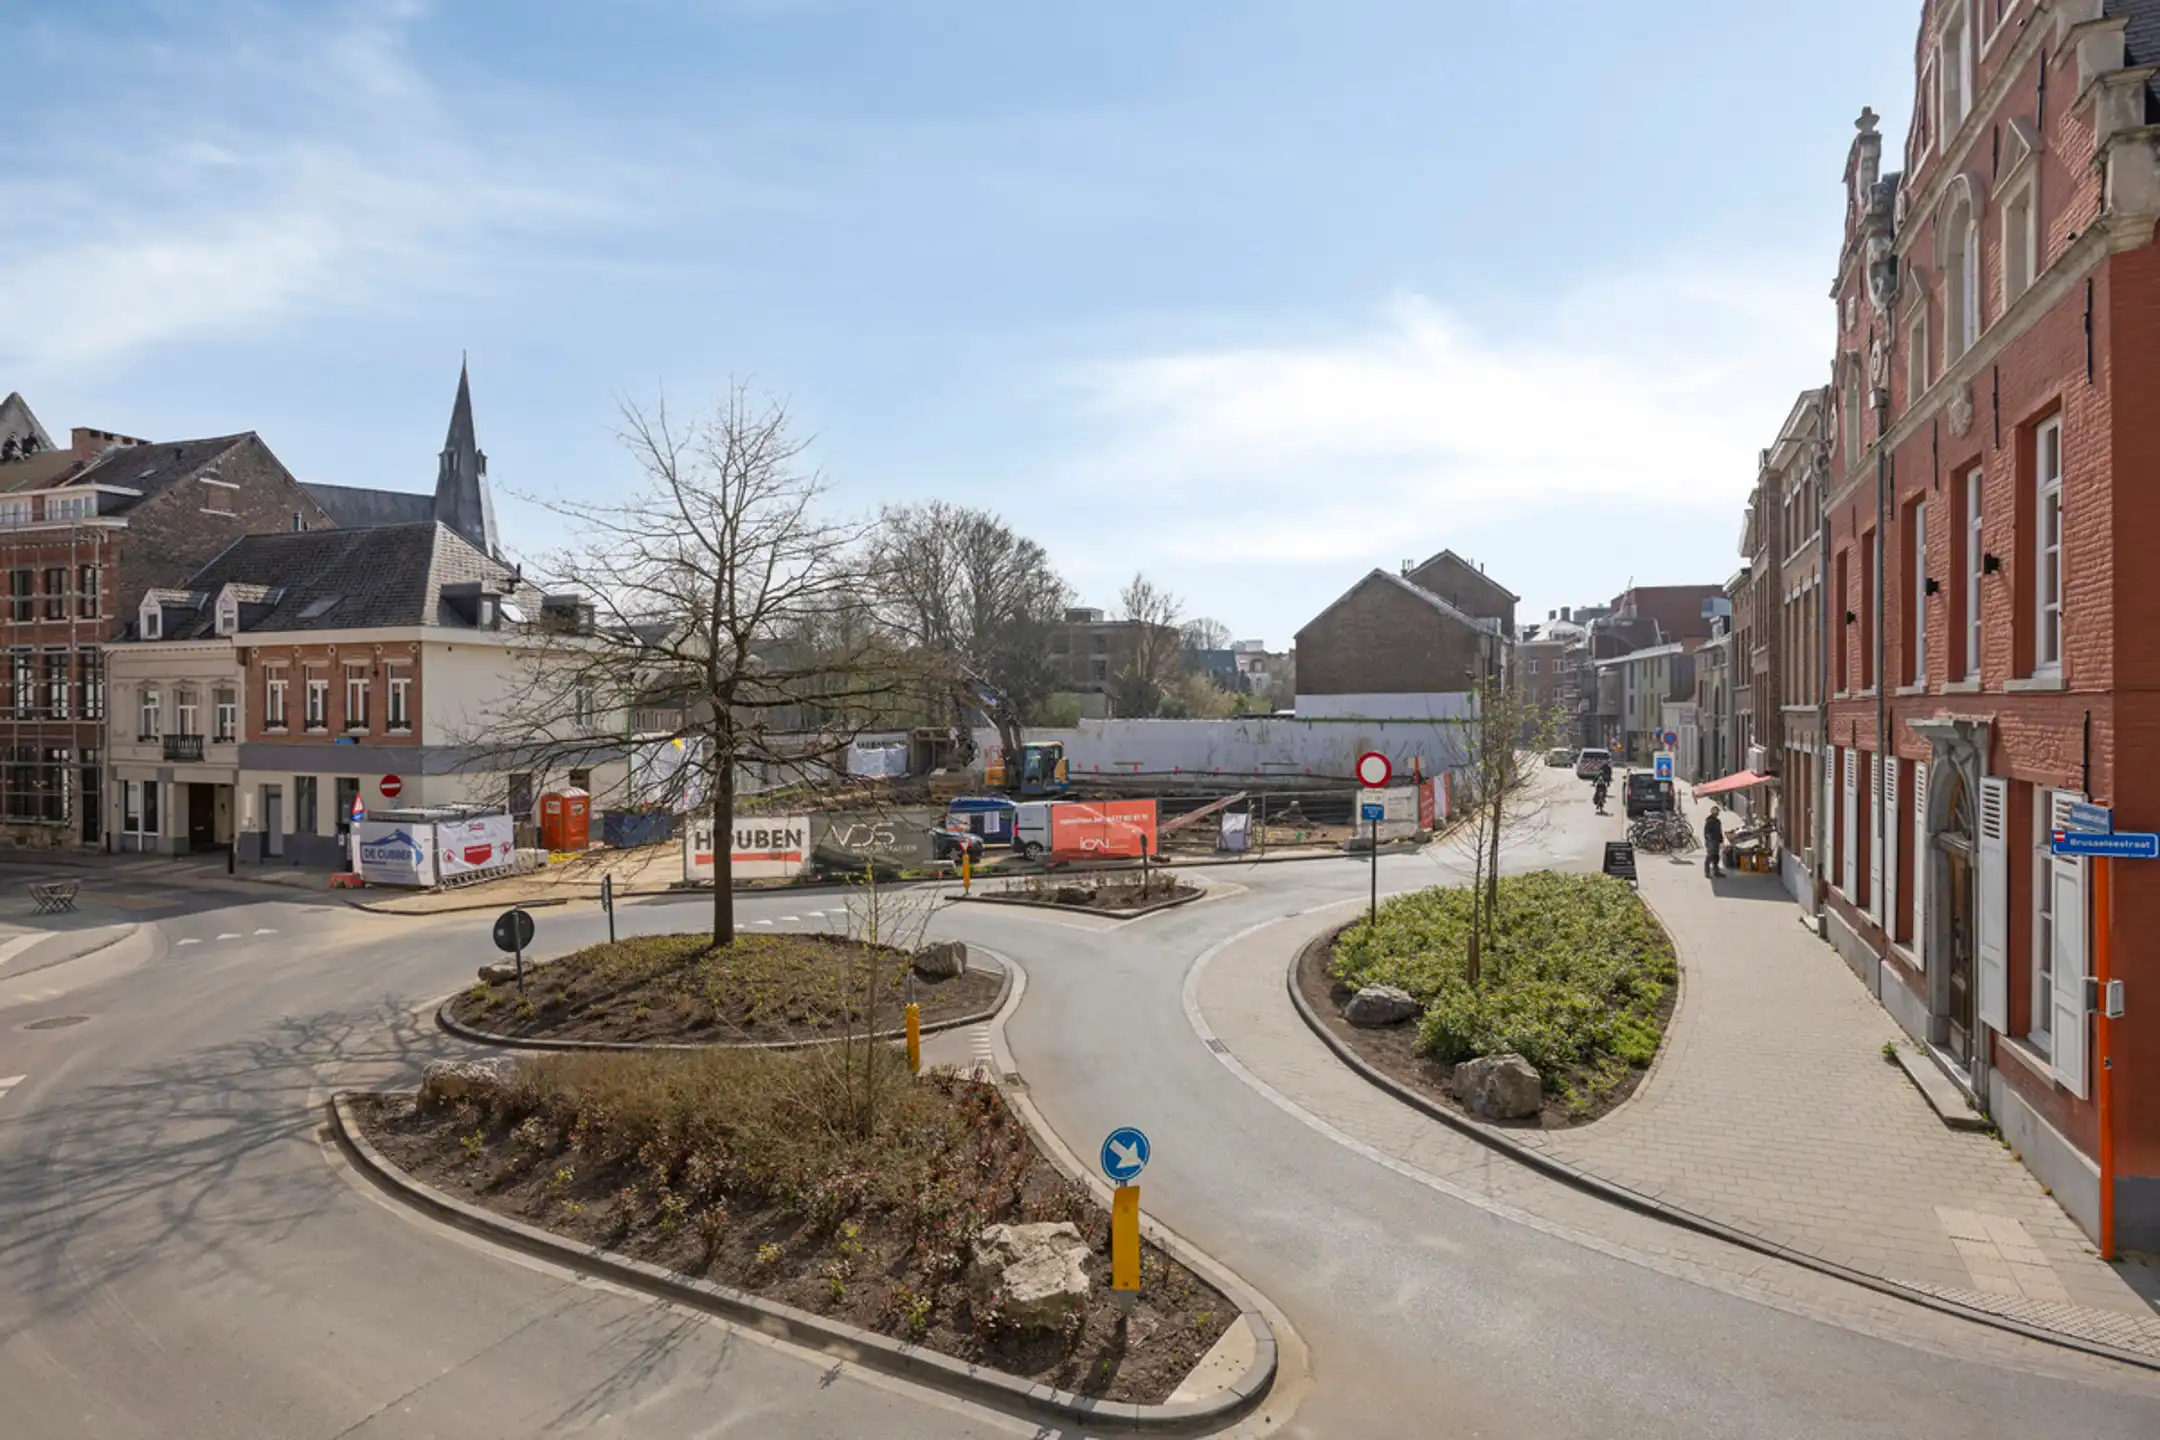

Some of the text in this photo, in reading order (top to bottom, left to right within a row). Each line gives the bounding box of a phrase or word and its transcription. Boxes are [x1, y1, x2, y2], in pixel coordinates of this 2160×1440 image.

[695, 828, 802, 850] HUBEN
[831, 822, 895, 847] VDS
[2069, 838, 2151, 849] Brusselsestraat
[363, 847, 376, 859] DE
